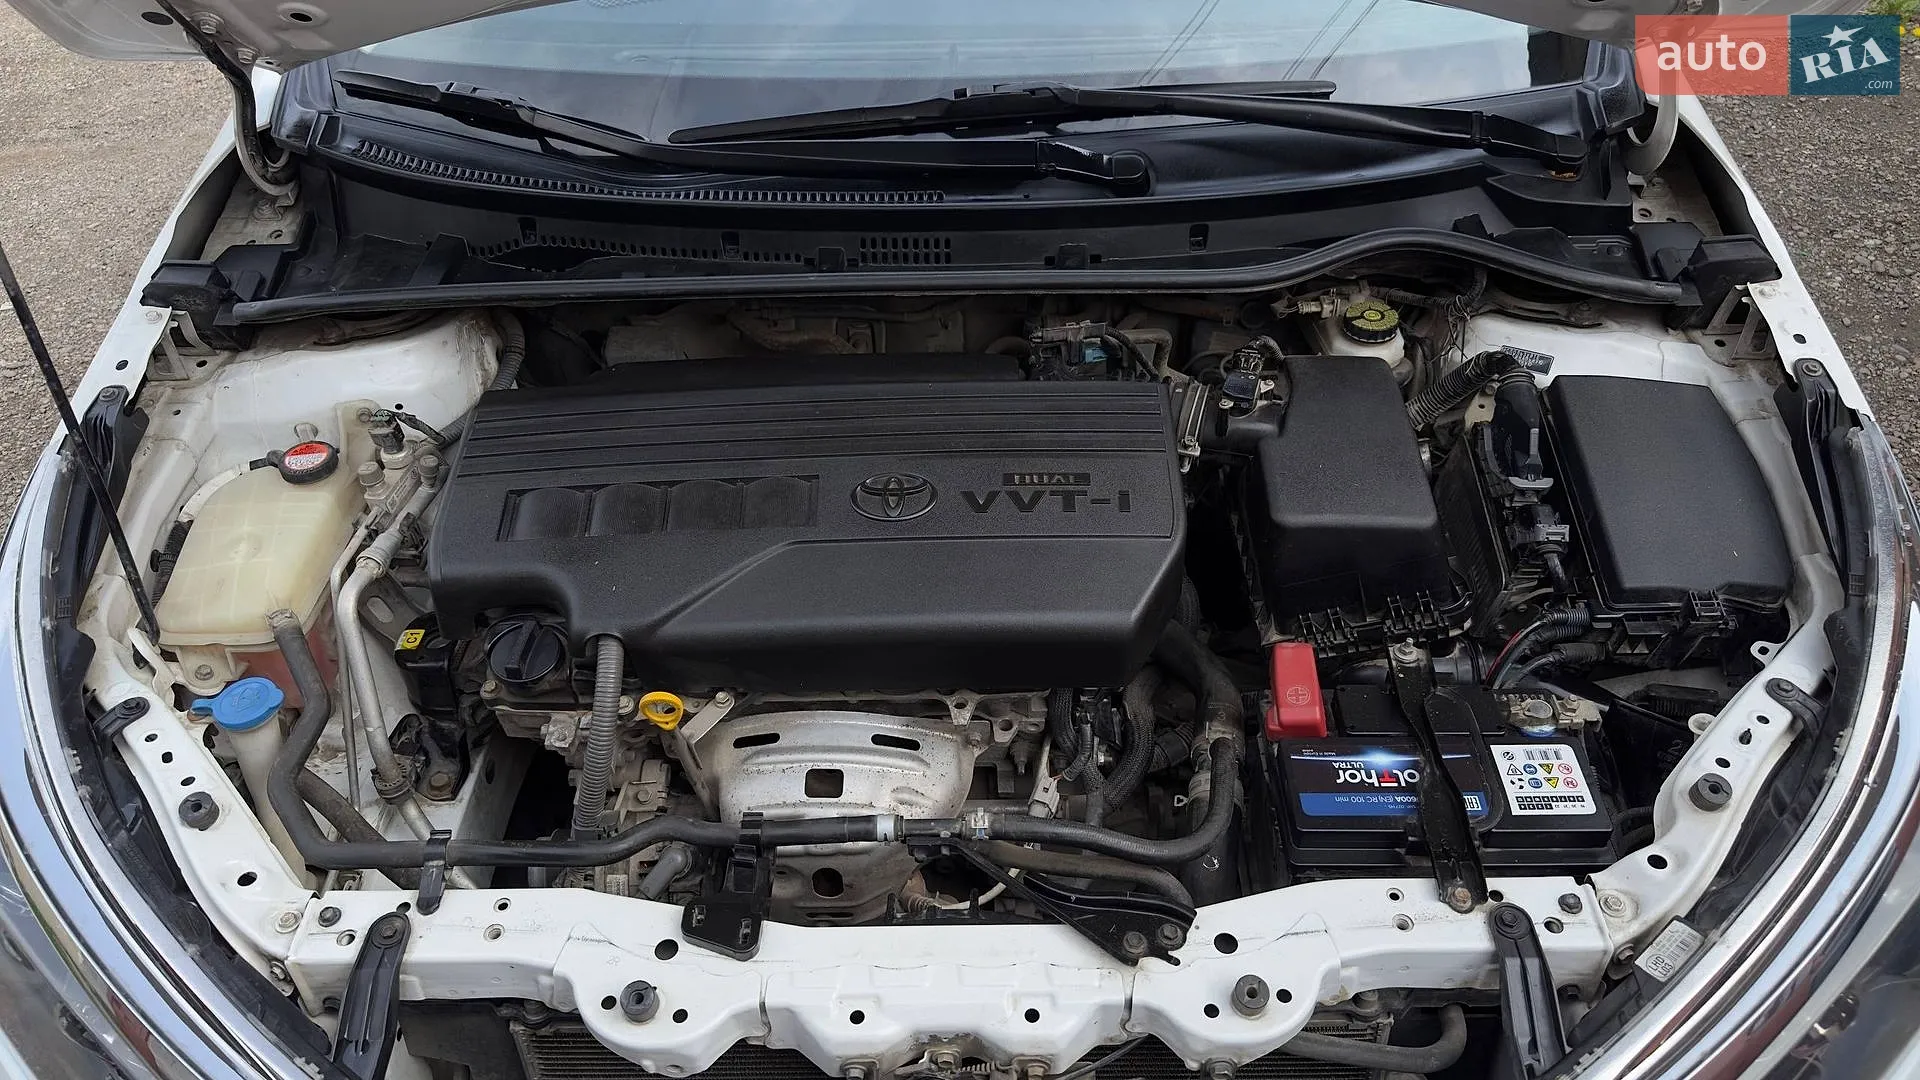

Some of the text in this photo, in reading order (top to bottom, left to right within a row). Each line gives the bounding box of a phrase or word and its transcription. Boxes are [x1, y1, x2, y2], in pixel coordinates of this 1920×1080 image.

[406, 632, 420, 644] C1
[1332, 761, 1363, 769] ULTRA
[1336, 768, 1420, 787] olThor
[1335, 795, 1349, 803] min
[1350, 795, 1365, 803] 100
[1378, 794, 1394, 803] (EN)
[1648, 956, 1665, 972] LHD
